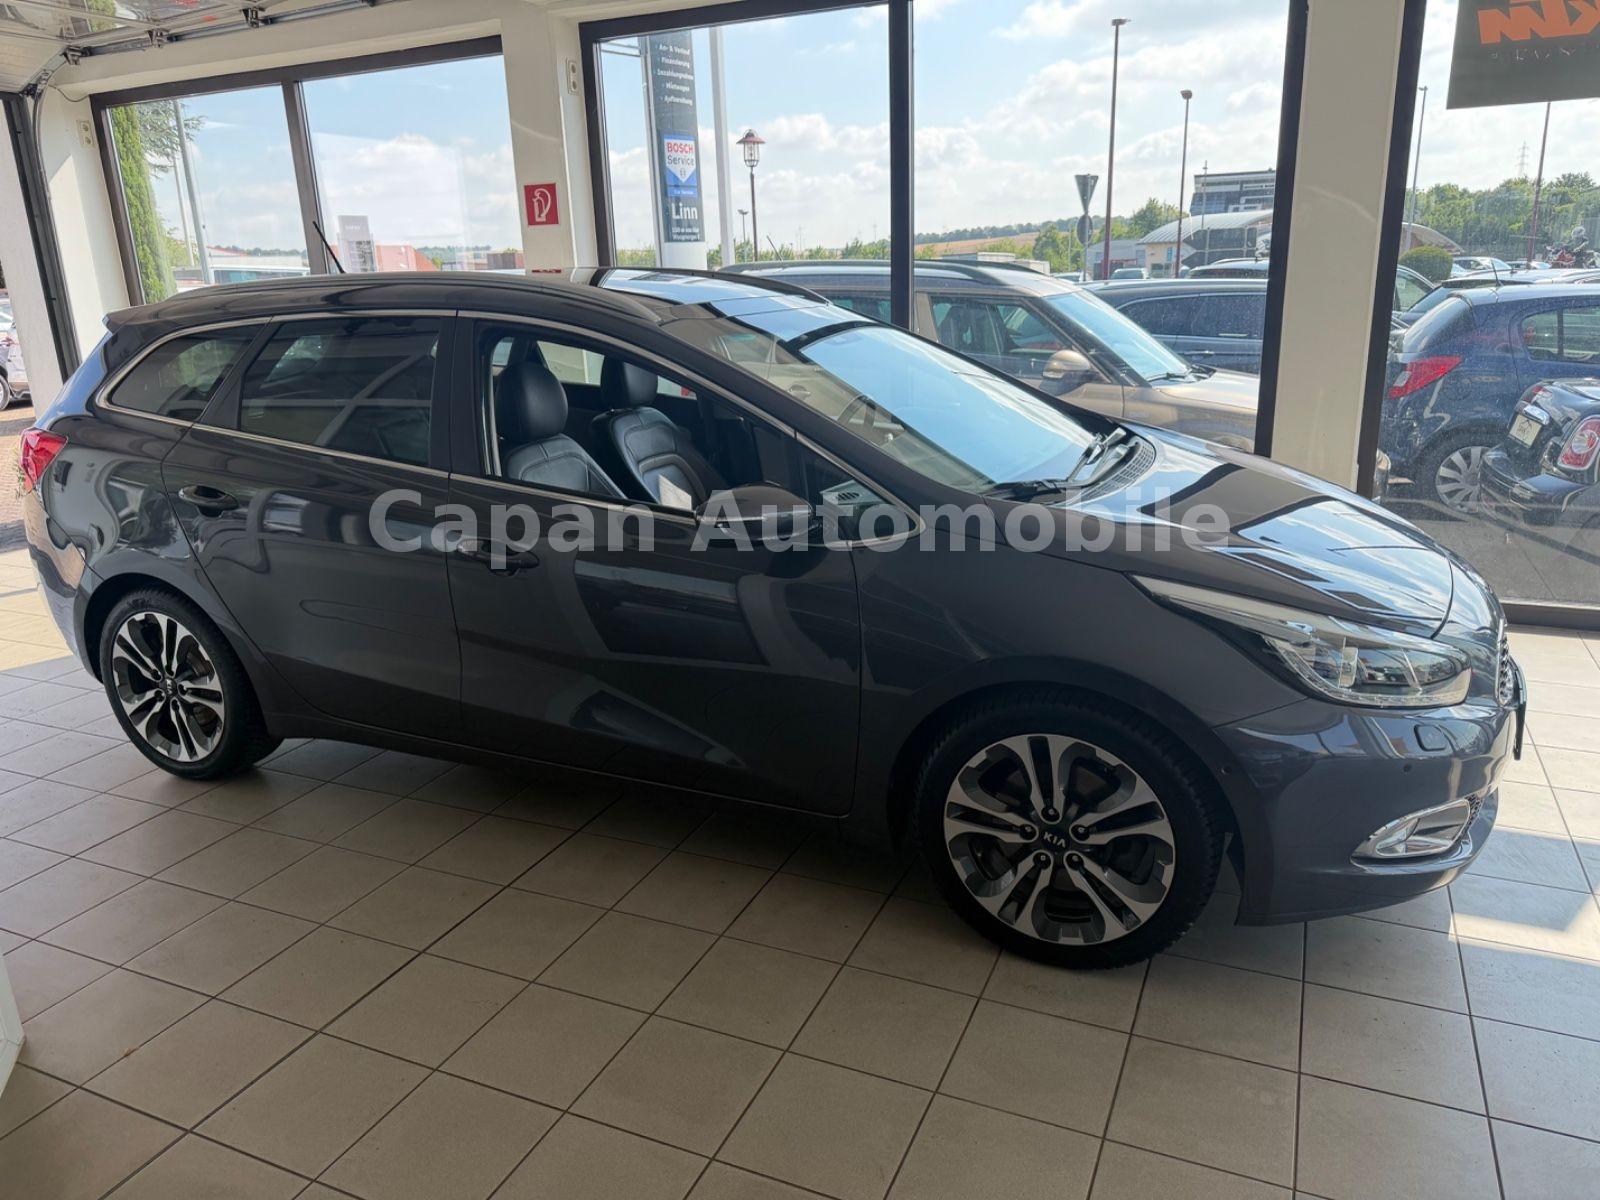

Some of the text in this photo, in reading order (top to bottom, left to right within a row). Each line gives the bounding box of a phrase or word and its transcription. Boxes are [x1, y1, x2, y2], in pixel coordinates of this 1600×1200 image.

[667, 142, 694, 154] BOSCH
[667, 154, 694, 166] Service
[671, 203, 698, 220] Linn
[1044, 831, 1066, 848] KIA
